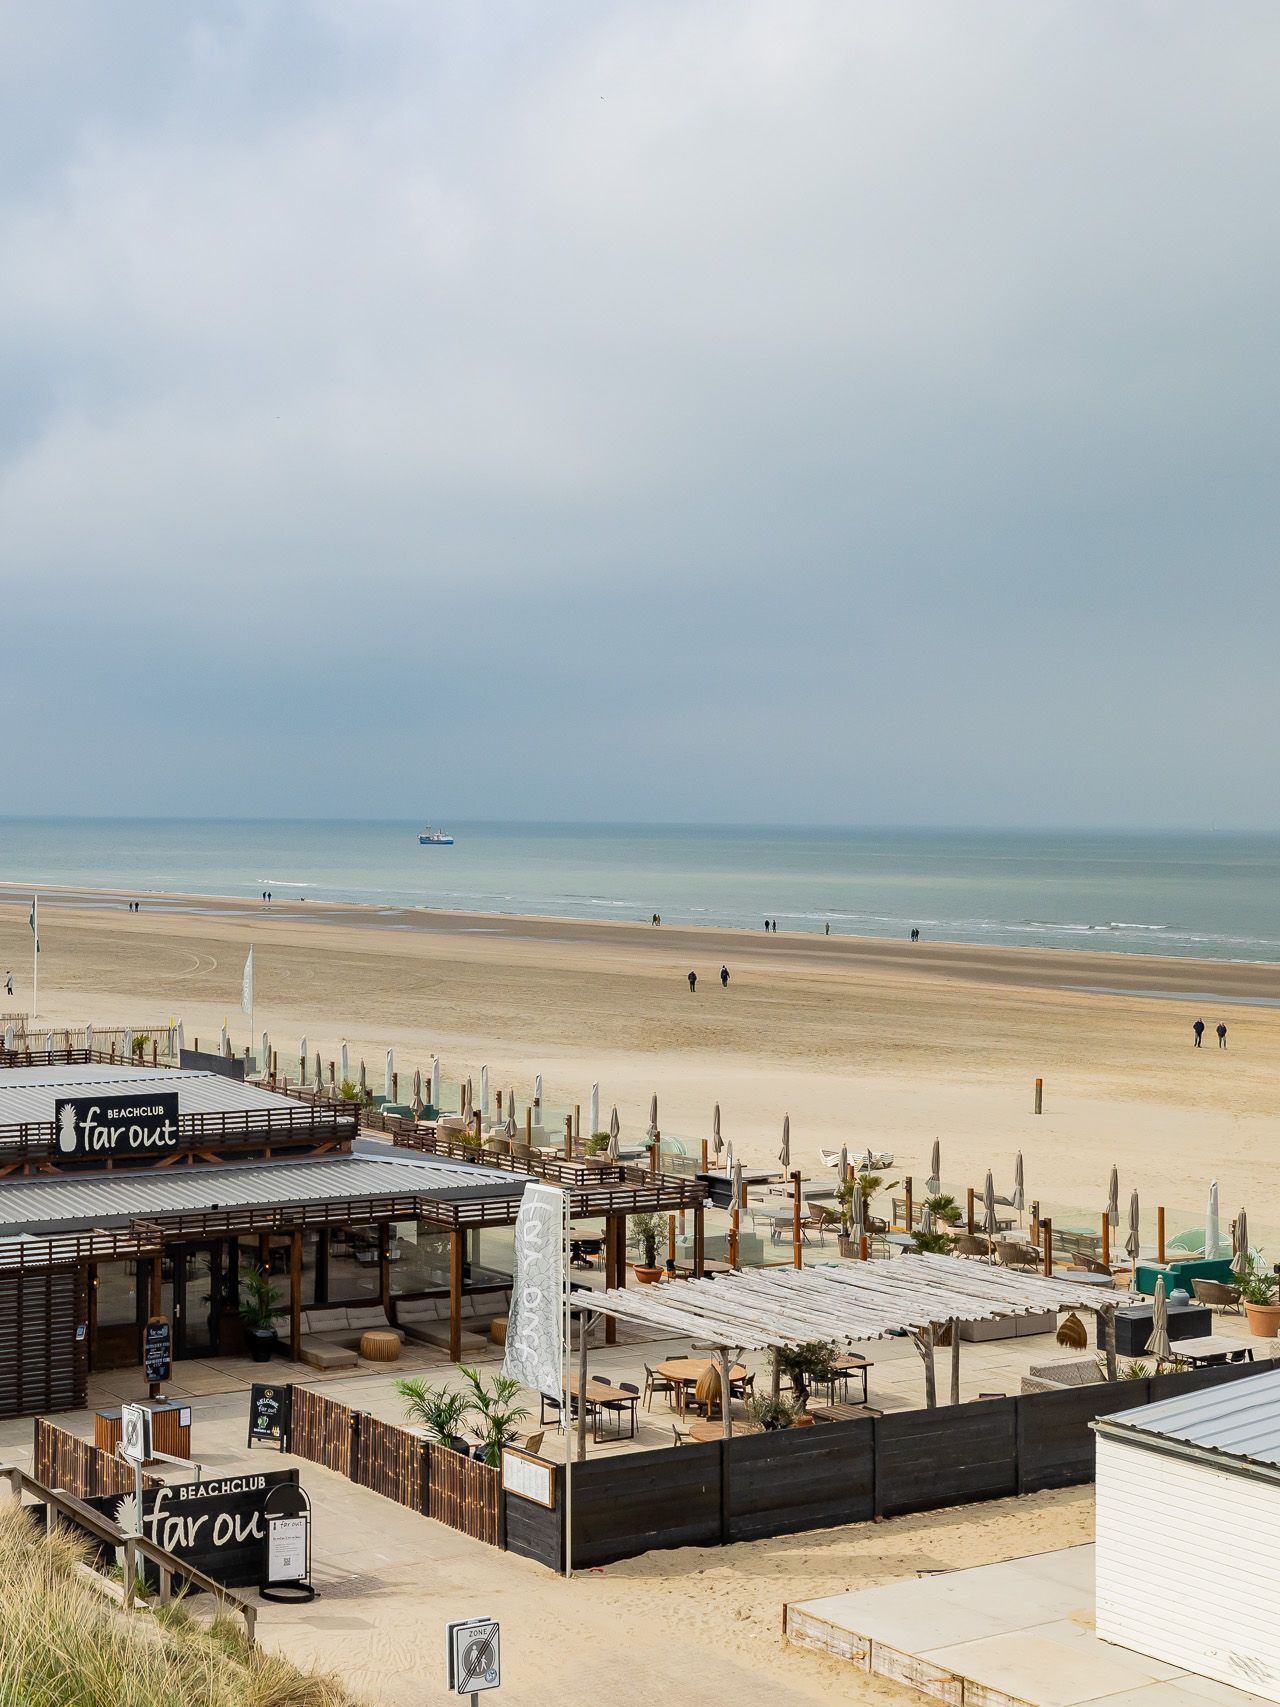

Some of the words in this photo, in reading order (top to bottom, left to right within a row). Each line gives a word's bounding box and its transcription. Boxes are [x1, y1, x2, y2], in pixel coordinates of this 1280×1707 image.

[107, 1105, 164, 1119] BEACHCLUB
[79, 1106, 126, 1151] far
[128, 1119, 177, 1148] out
[256, 1397, 279, 1409] WELCOME
[258, 1404, 267, 1413] far
[179, 1476, 266, 1500] BEACHCLUB
[143, 1487, 209, 1553] far
[213, 1510, 284, 1547] ou
[280, 1520, 291, 1529] far
[468, 1628, 488, 1638] ZONE
